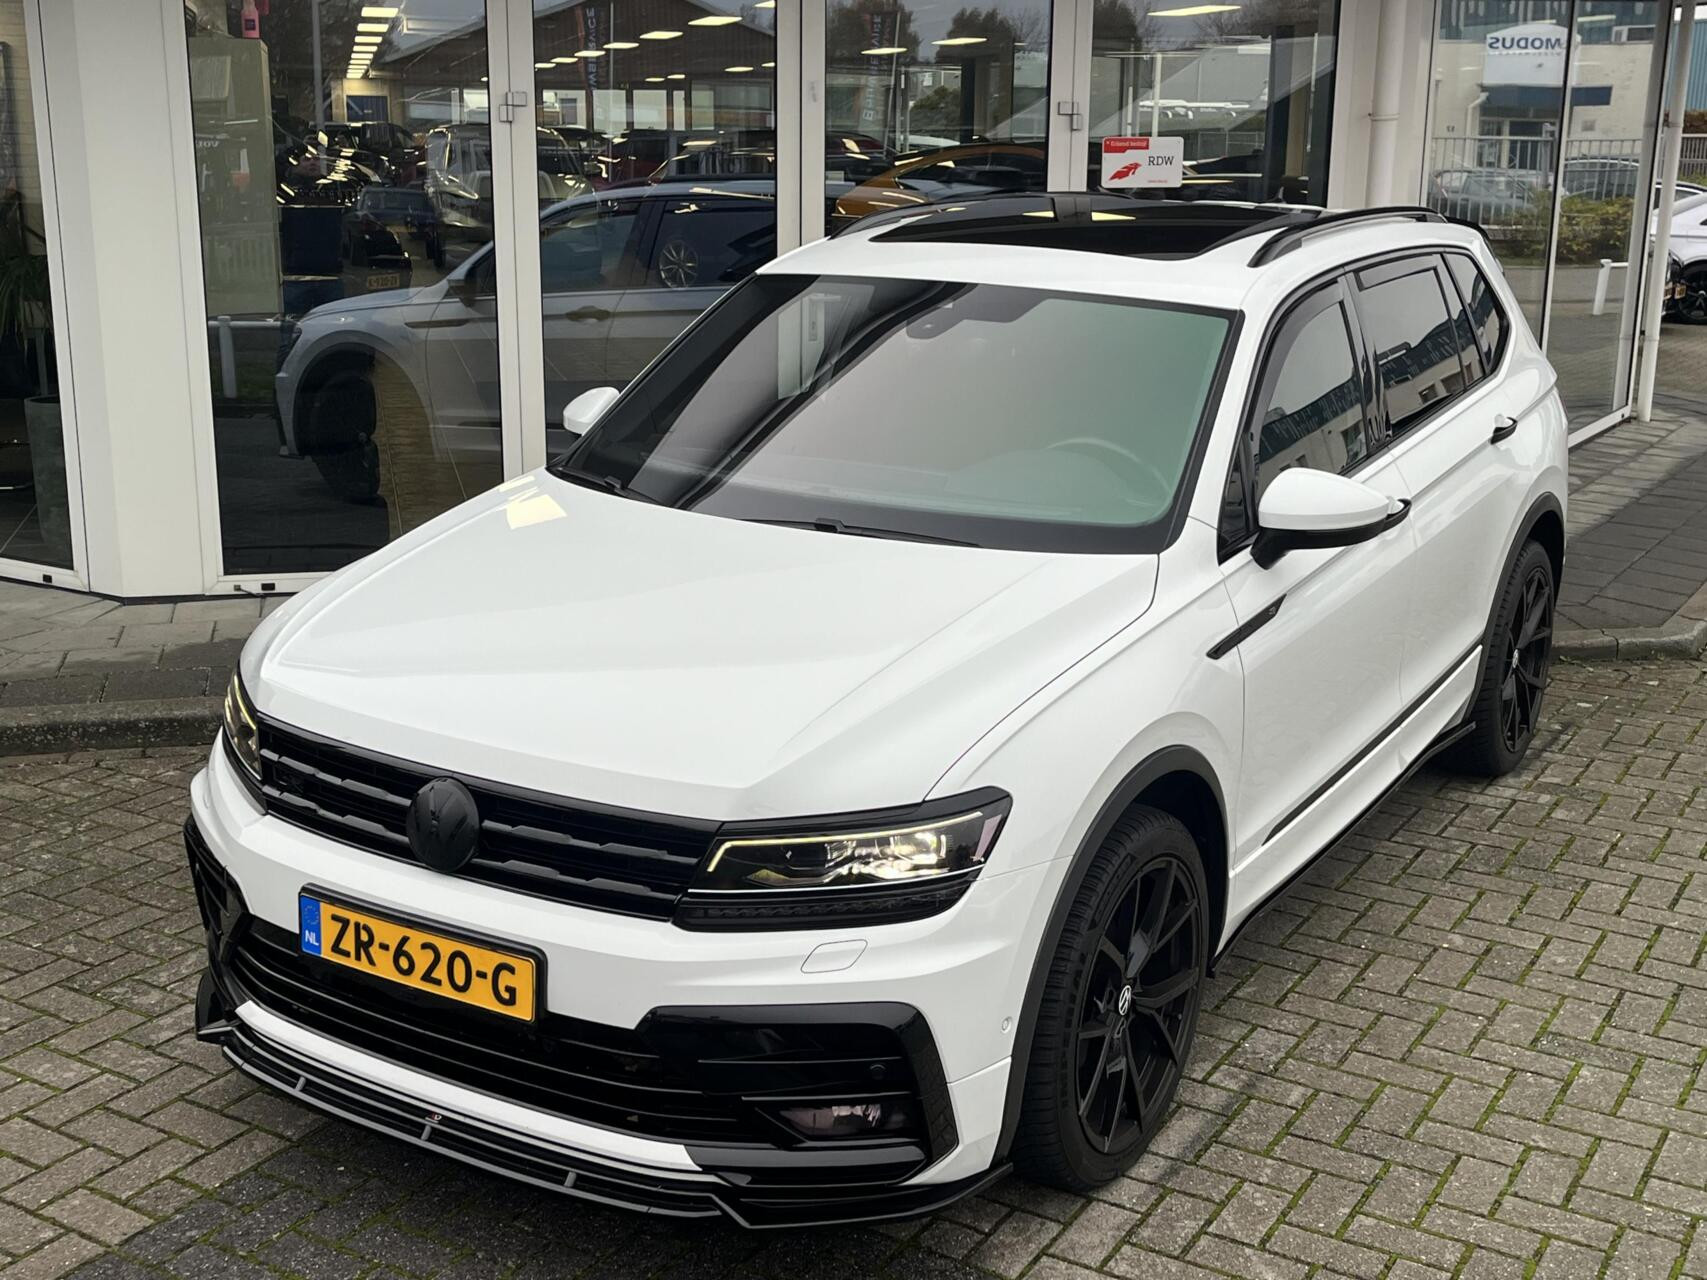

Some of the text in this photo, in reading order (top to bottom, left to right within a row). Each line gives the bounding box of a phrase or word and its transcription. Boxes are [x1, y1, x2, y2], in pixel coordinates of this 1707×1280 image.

[1148, 155, 1175, 166] RDW
[305, 929, 319, 946] NL
[330, 913, 517, 1007] ZR-620-G
